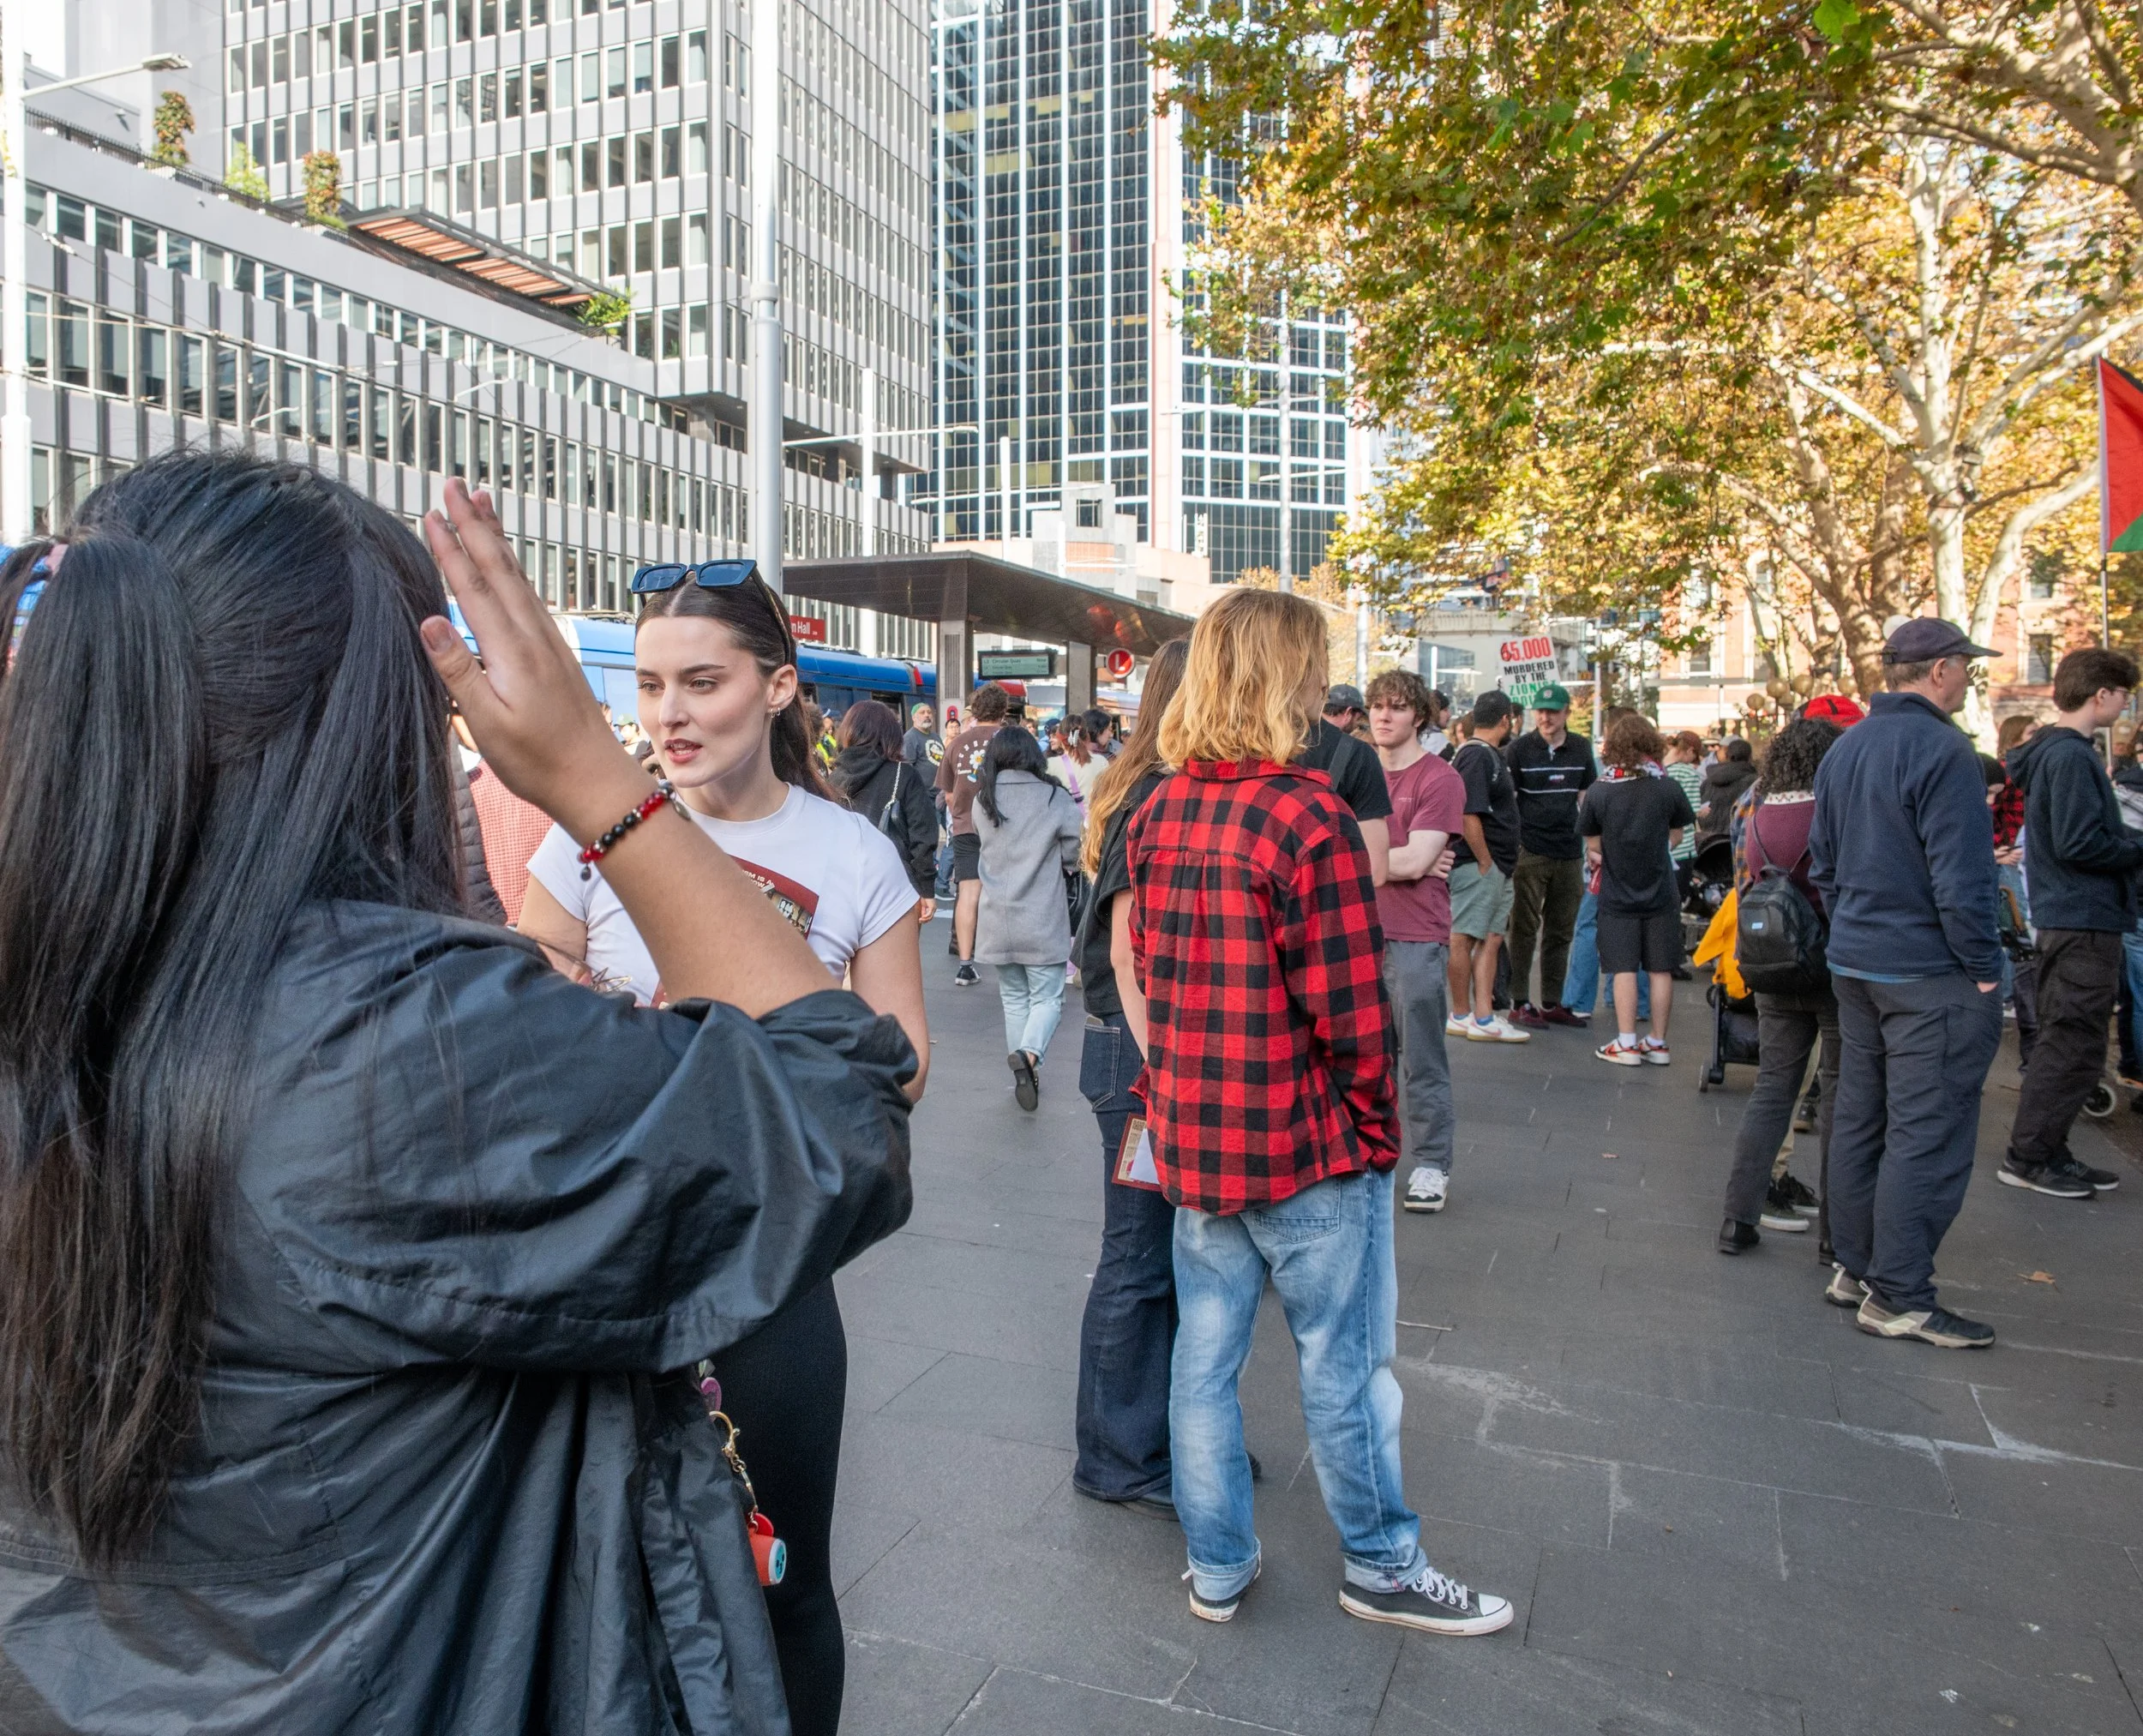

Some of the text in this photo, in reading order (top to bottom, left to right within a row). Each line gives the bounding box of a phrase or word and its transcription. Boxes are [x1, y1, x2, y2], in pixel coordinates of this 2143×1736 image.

[797, 621, 810, 634] Hall
[1504, 660, 1555, 676] MURDERED
[1515, 672, 1546, 684] BY THE
